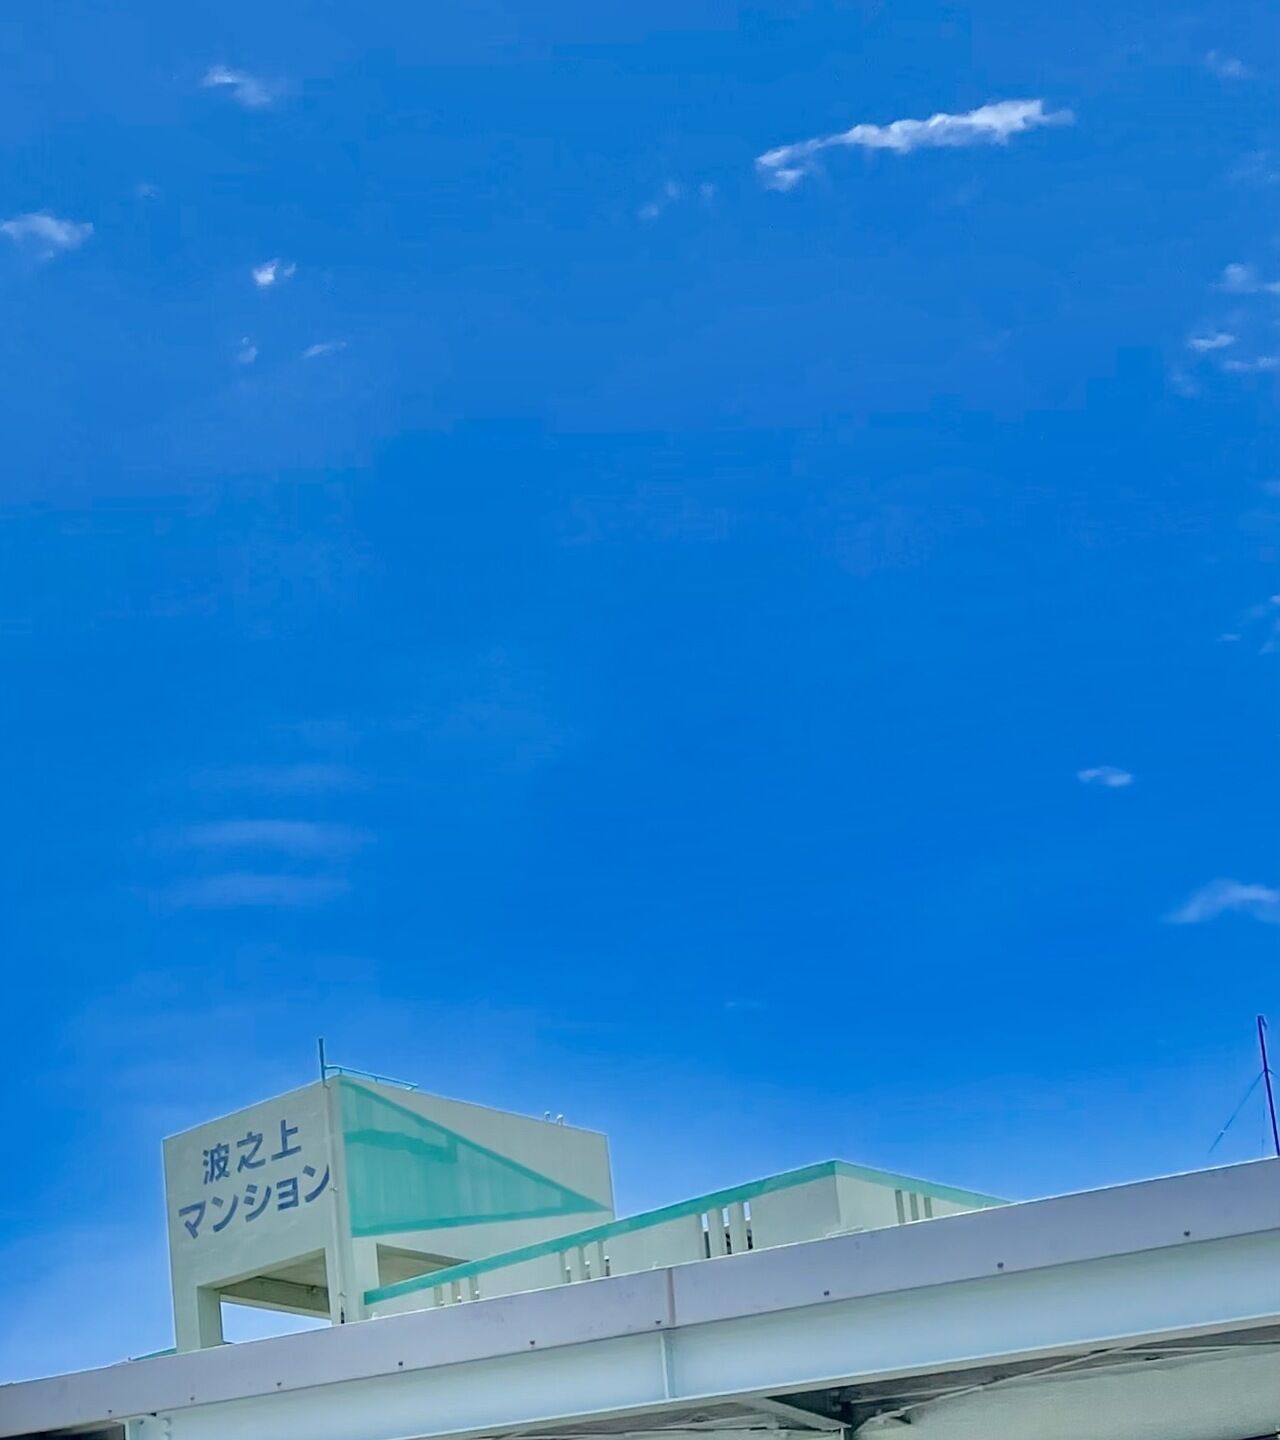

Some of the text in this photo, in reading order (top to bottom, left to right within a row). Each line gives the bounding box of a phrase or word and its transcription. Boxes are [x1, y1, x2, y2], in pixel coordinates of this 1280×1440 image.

[202, 1119, 302, 1185] 波之上
[178, 1163, 330, 1240] マンション
